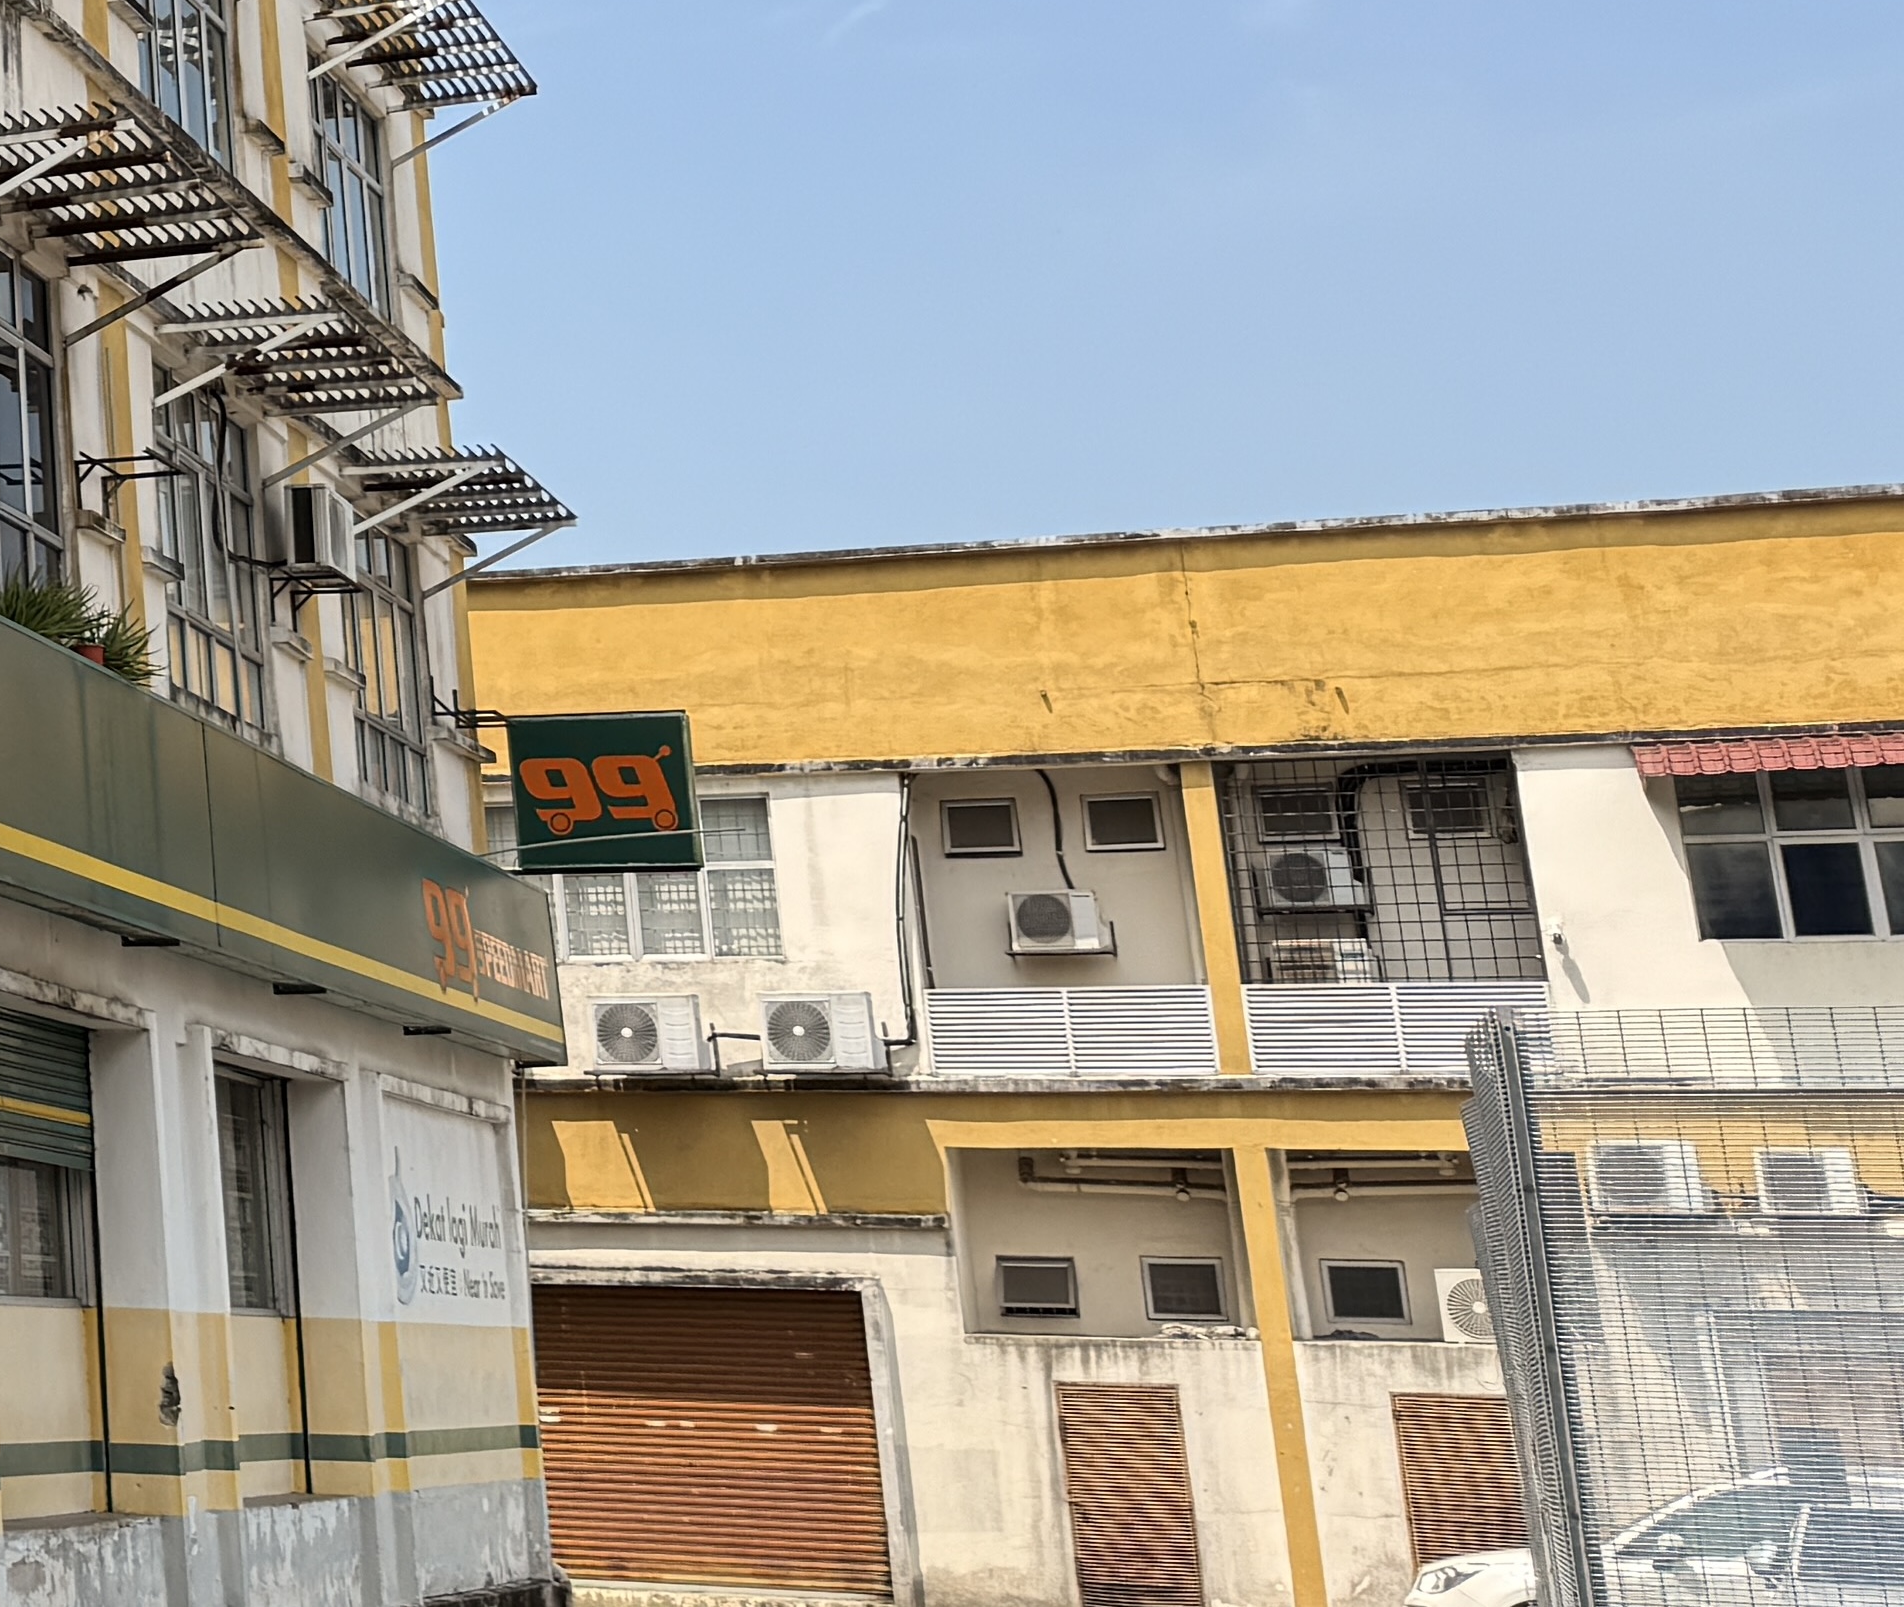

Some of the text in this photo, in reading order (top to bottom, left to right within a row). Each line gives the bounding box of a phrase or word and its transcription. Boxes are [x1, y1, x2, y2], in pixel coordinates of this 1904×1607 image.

[518, 745, 679, 836] 99
[422, 878, 479, 1006] 99
[414, 1193, 502, 1259] Dekat lagi Murah
